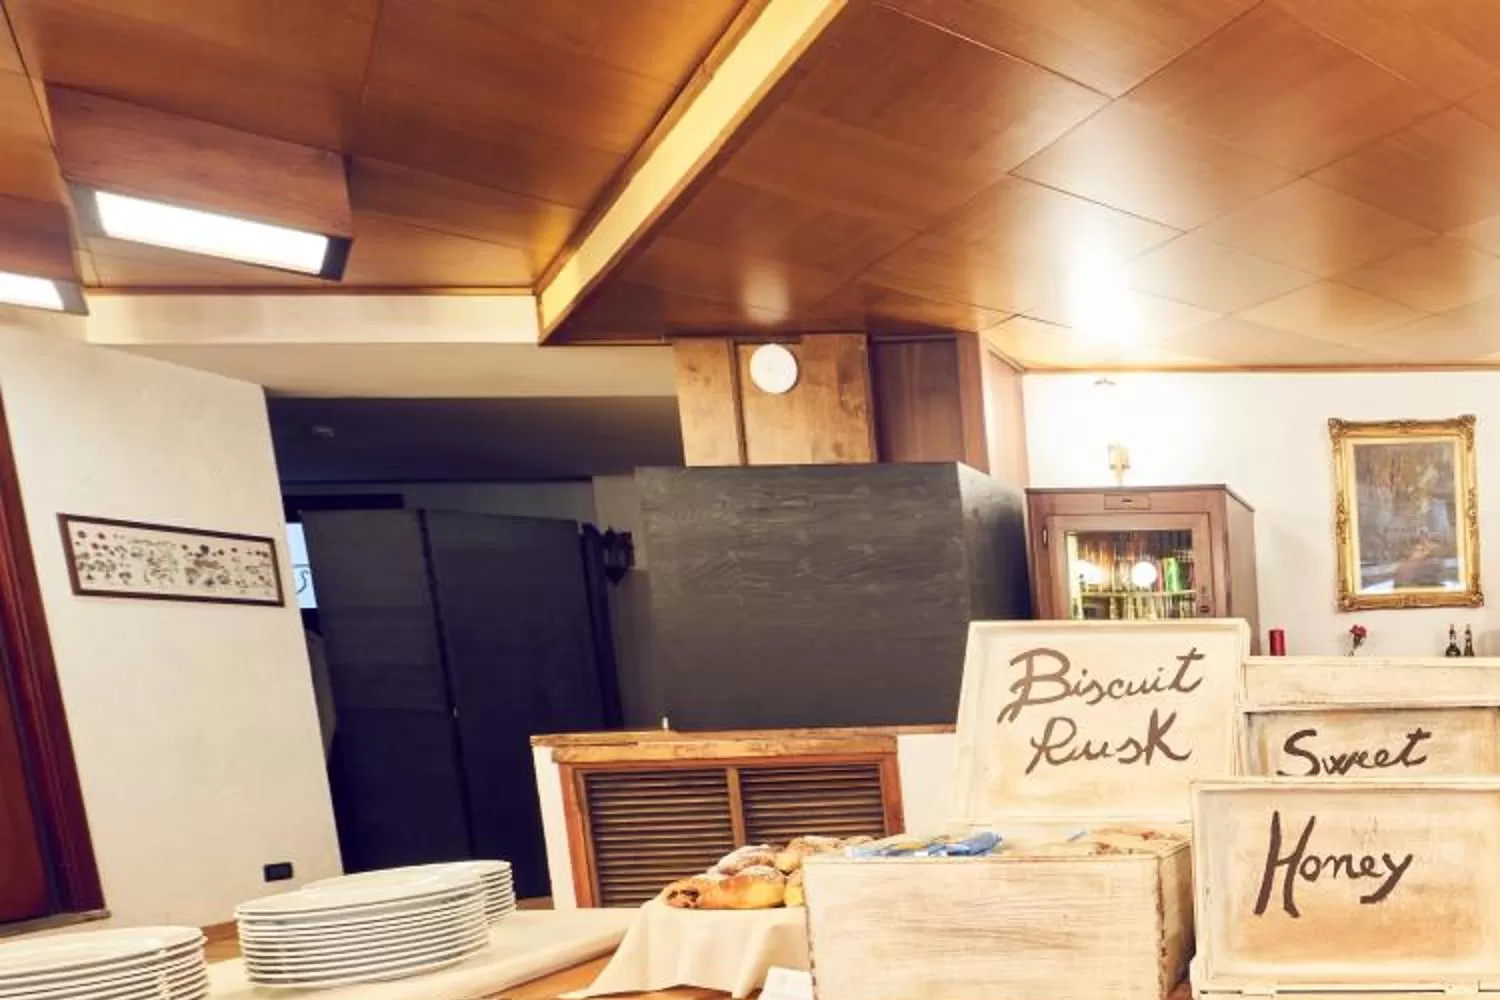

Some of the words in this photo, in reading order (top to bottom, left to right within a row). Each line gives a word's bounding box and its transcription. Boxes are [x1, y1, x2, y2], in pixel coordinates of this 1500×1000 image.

[997, 647, 1205, 724] Biscuit
[1276, 727, 1432, 776] Sweet
[1252, 810, 1413, 919] Honey
